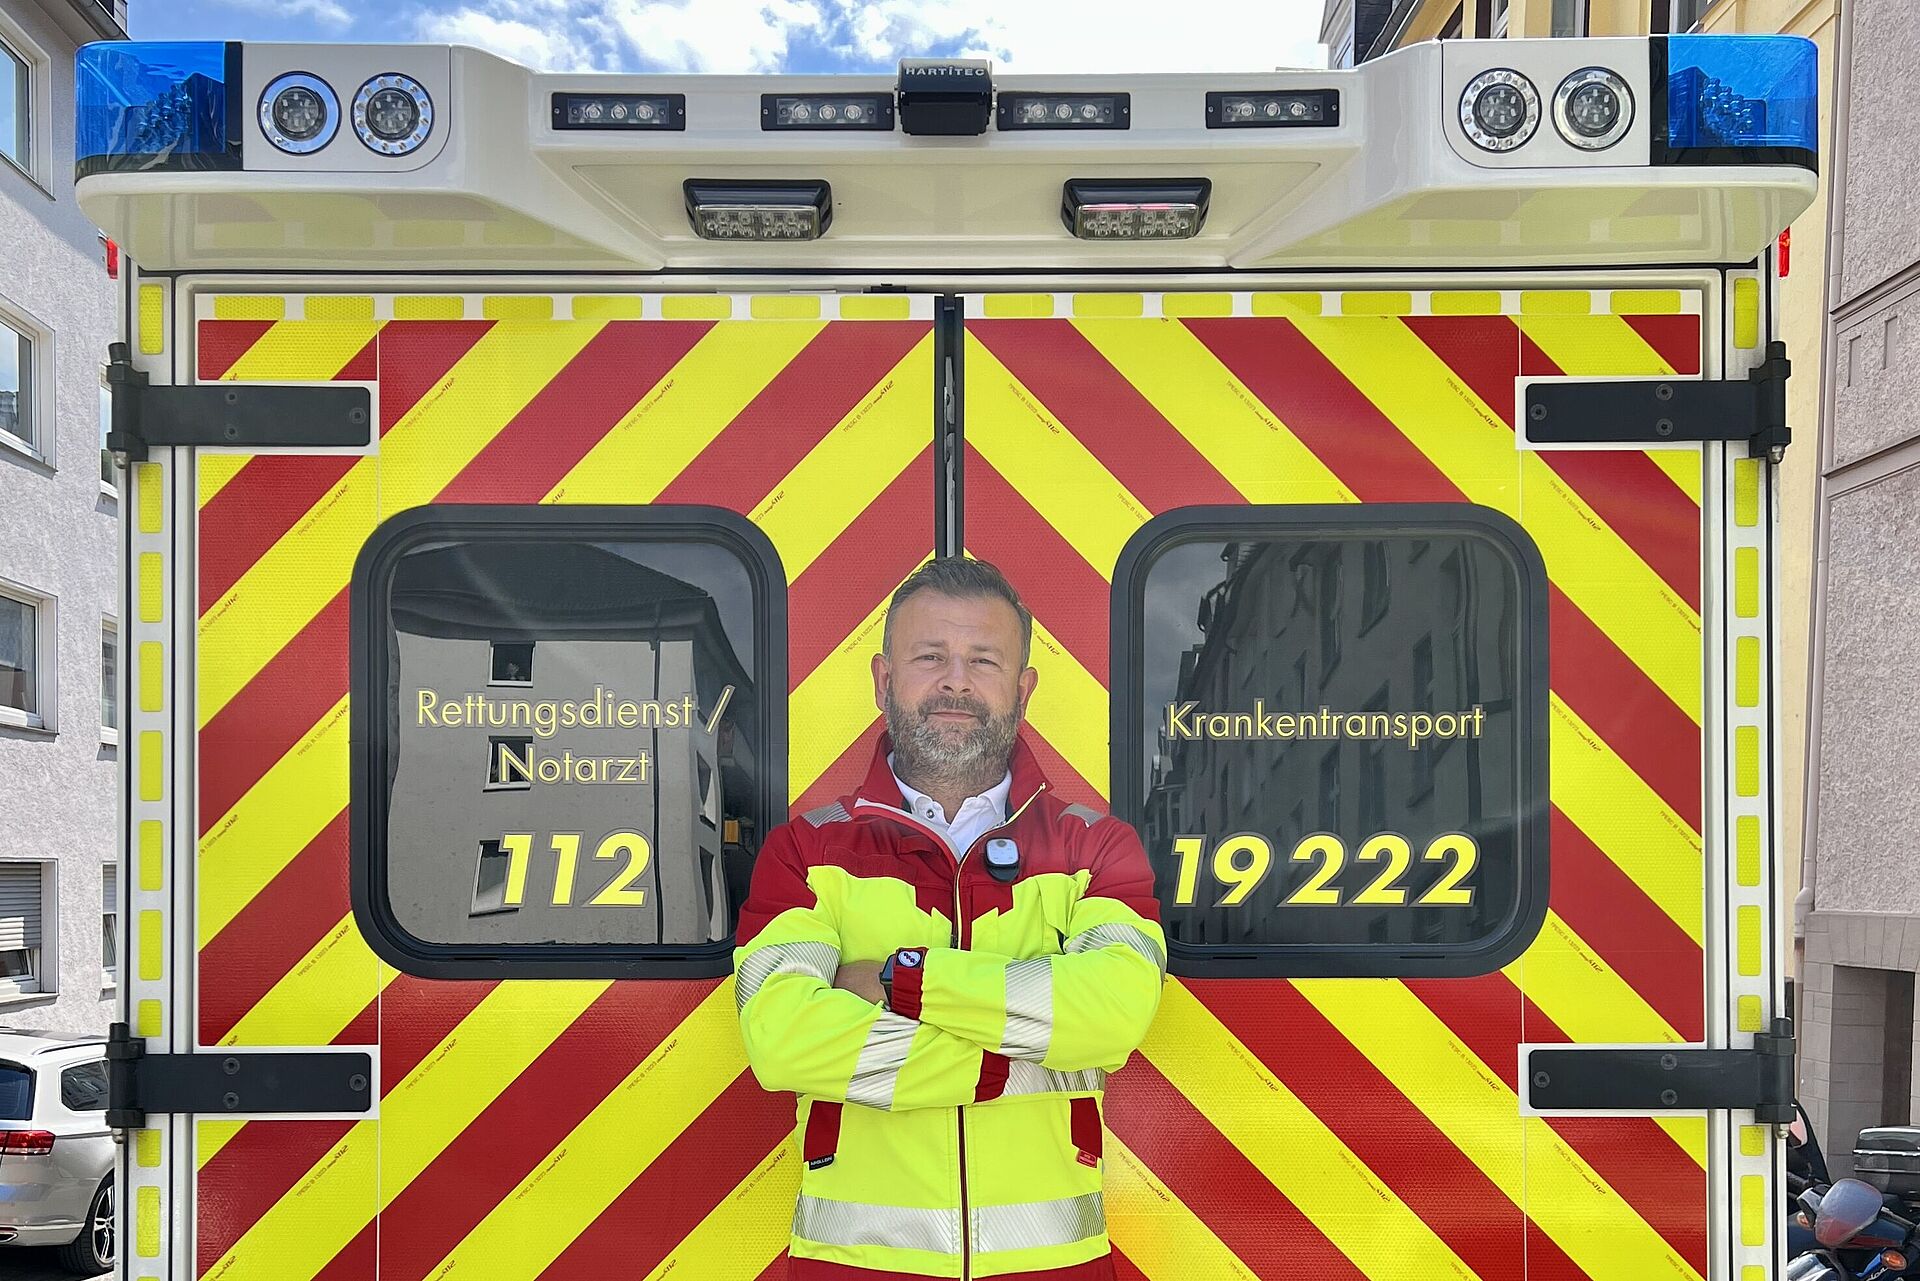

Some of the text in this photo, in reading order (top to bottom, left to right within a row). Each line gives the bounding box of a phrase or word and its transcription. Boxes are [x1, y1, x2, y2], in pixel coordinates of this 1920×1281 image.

[417, 687, 731, 738] Rettungsdienst /
[1170, 701, 1484, 747] Krankentransport
[500, 747, 649, 783] Notarzt
[502, 831, 651, 906] 112
[1172, 833, 1478, 905] 19 222
